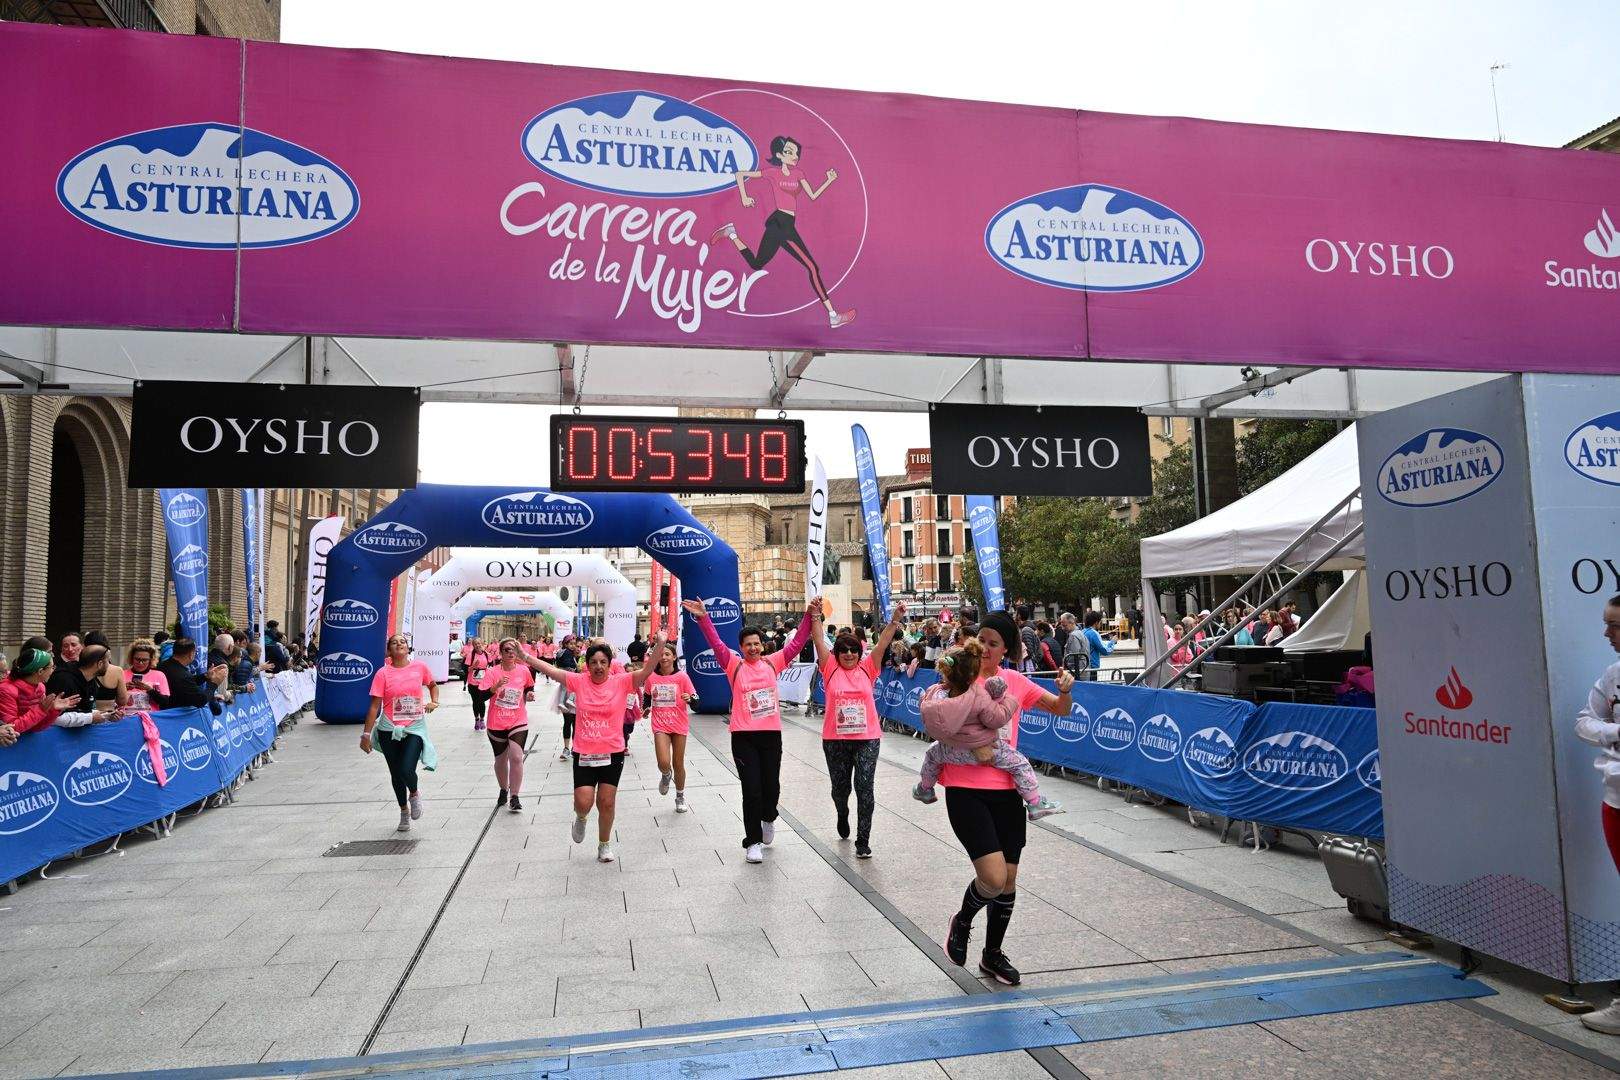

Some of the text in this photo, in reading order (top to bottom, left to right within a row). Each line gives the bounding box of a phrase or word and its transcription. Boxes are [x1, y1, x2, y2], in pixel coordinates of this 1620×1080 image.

[578, 123, 733, 144] CENTRAL LECHERA
[540, 123, 739, 174] ASTURIANA
[131, 162, 328, 184] CENTRAL LECHERA
[81, 163, 337, 220] ASTURIANA
[500, 181, 697, 247] Carrera
[1037, 218, 1180, 235] CENTRAL LECHERA
[1004, 219, 1188, 266] ASTURIANA
[1305, 238, 1454, 279] OYSHO
[549, 242, 769, 333] de la Mujer
[180, 415, 379, 457] OYSHO
[967, 435, 1120, 469] OYSHO
[1401, 445, 1488, 469] CENTRAL LECHERA
[1386, 456, 1494, 494] ASTURIANA
[491, 505, 585, 525] ASTURIANA
[358, 532, 421, 547] ASTURIANA
[652, 536, 709, 548] ASTURIANA
[486, 561, 572, 577] OYSHO
[1386, 561, 1512, 601] OYSHO
[325, 608, 374, 622] ASTURIANA
[708, 608, 738, 618] TURIANA
[417, 648, 444, 656] OYSHO
[319, 662, 369, 675] ASTURIANA
[583, 720, 610, 729] ORSAL
[1055, 716, 1087, 734] ASTURIANA
[1095, 721, 1132, 742] ASTURIANA
[1404, 712, 1512, 744] Santander
[142, 755, 178, 776] ASIANA
[1250, 751, 1339, 778] ASTURIANA
[71, 769, 129, 798] ASTURIANA
